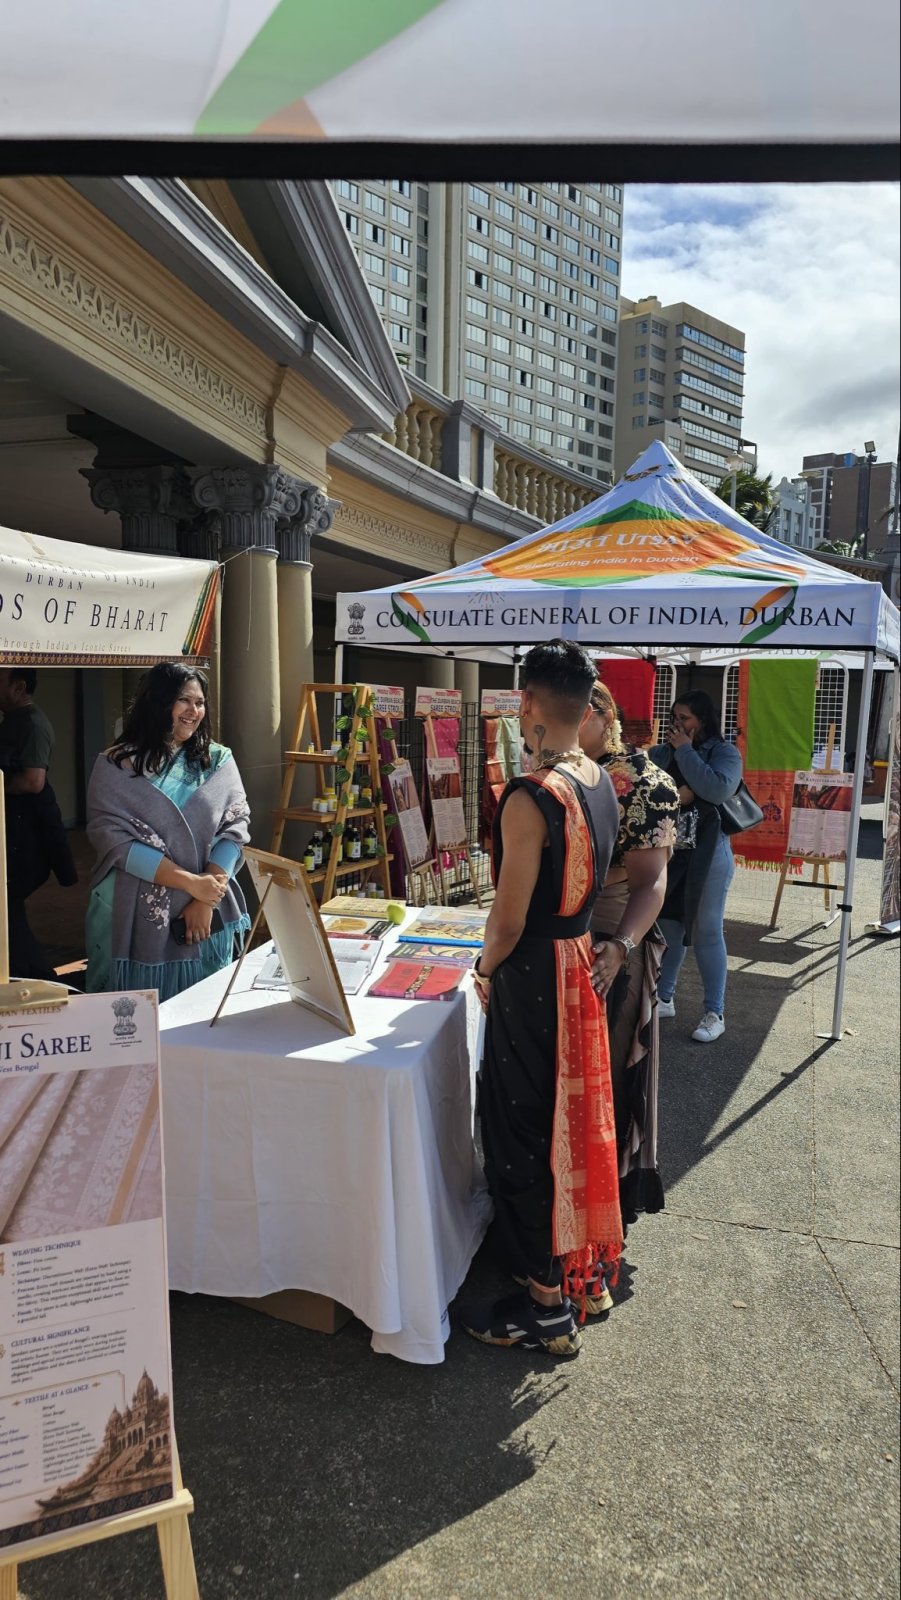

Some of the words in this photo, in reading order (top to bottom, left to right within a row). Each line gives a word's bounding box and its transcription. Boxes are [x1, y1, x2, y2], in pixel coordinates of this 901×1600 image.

[26, 572, 83, 591] DURBAN
[44, 598, 77, 624] OF
[90, 603, 168, 632] BHARAT
[376, 608, 494, 628] CONSULATE
[501, 606, 602, 626] GENERAL
[608, 606, 640, 625] OF
[648, 606, 729, 627] INDIA,
[739, 606, 856, 627] DURBAN
[0, 637, 41, 652] hrough
[22, 1005, 61, 1016] TEXTILES
[15, 1062, 39, 1073] Bengal
[12, 1246, 43, 1257] WEAVING
[44, 1239, 81, 1252] TECHNIQUE
[11, 1335, 45, 1348] CULTURAL
[47, 1325, 90, 1340] SIGNIFICANCE
